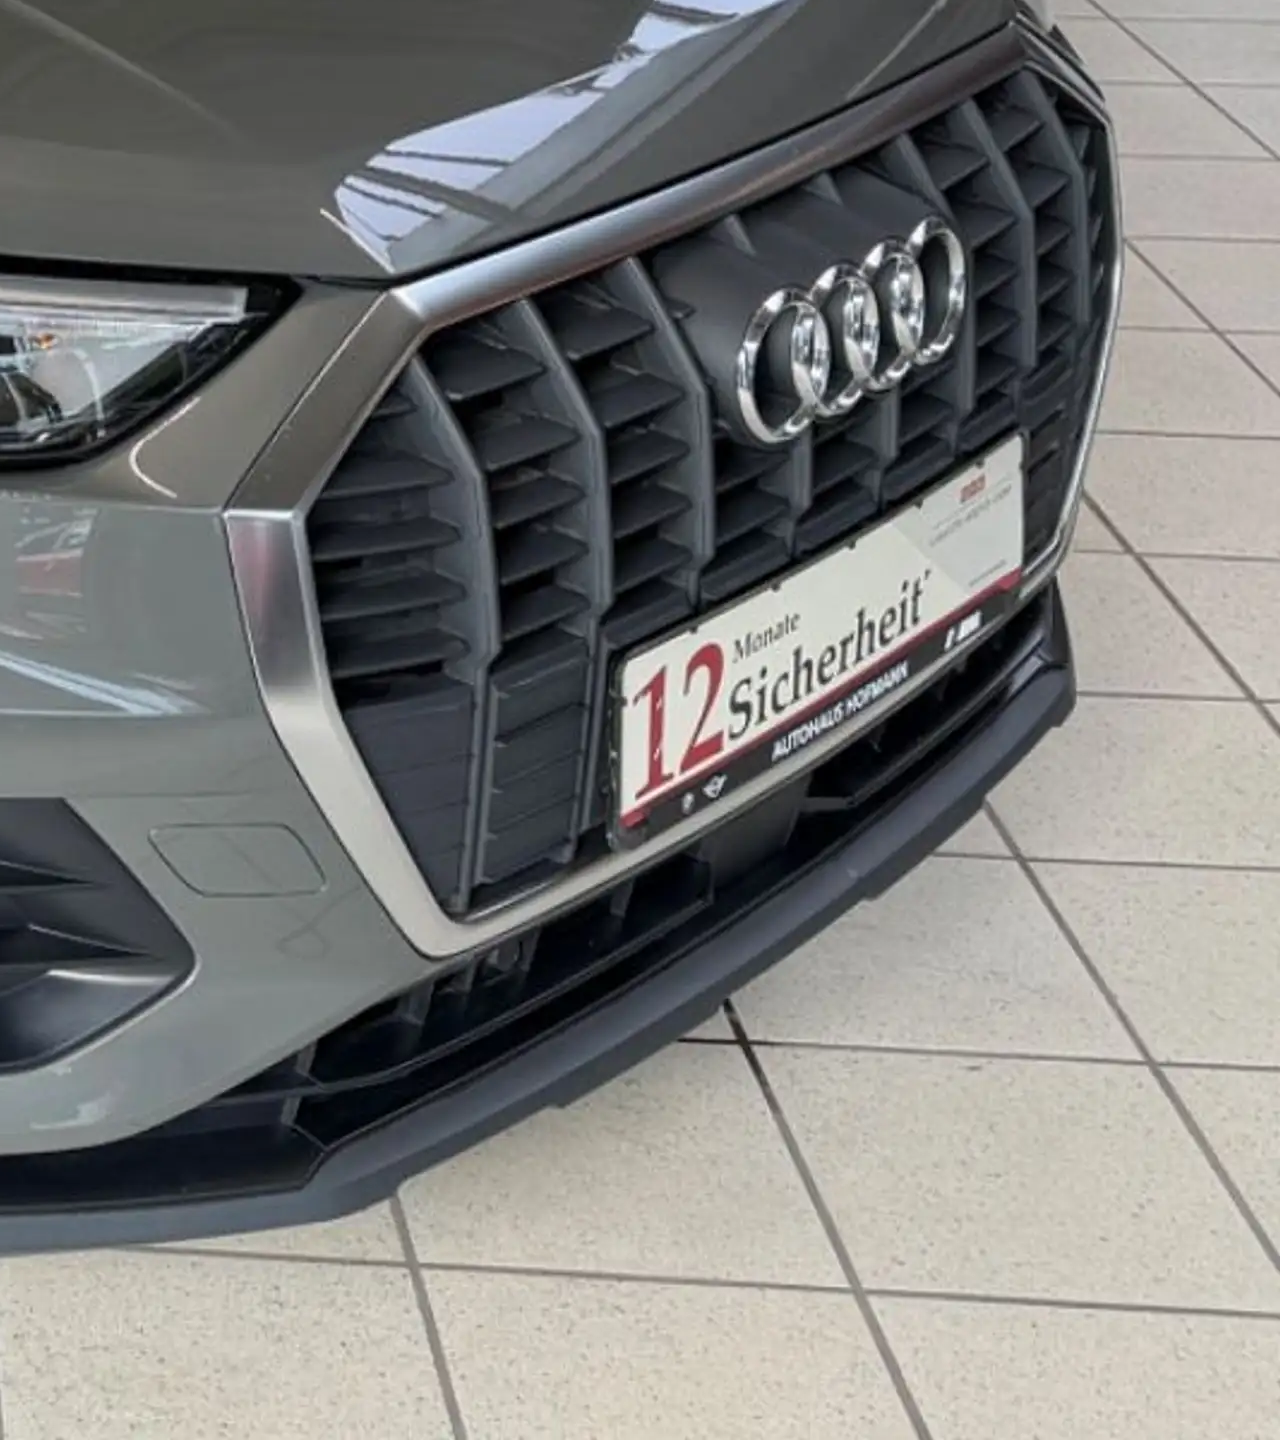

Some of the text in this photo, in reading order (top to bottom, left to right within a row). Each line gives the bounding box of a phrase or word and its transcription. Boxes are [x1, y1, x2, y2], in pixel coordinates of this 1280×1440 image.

[732, 613, 801, 663] Monate
[633, 641, 725, 800] 12
[771, 700, 845, 762] AUTOHAUS
